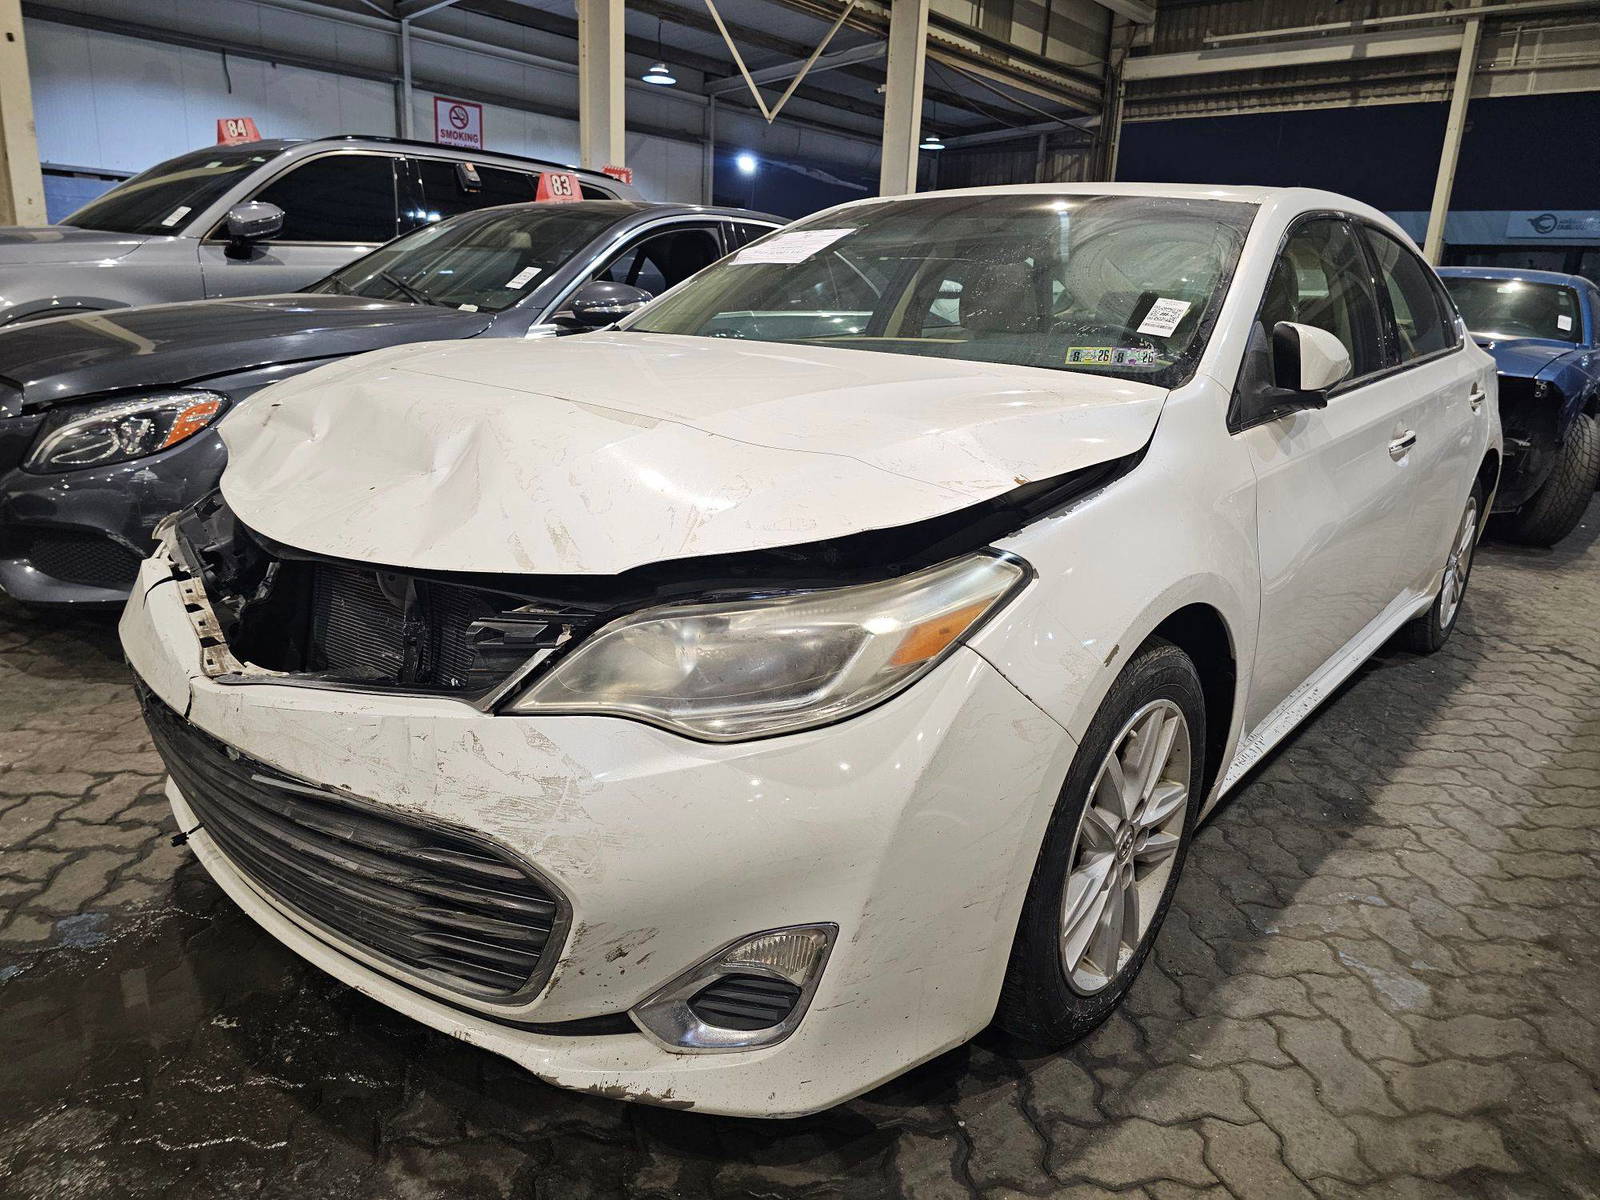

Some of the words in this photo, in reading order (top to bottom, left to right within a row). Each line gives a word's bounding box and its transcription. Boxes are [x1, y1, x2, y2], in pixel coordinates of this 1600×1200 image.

[227, 120, 247, 137] 84
[440, 128, 479, 143] SMOKING
[551, 174, 572, 196] 83
[1097, 349, 1110, 362] 26
